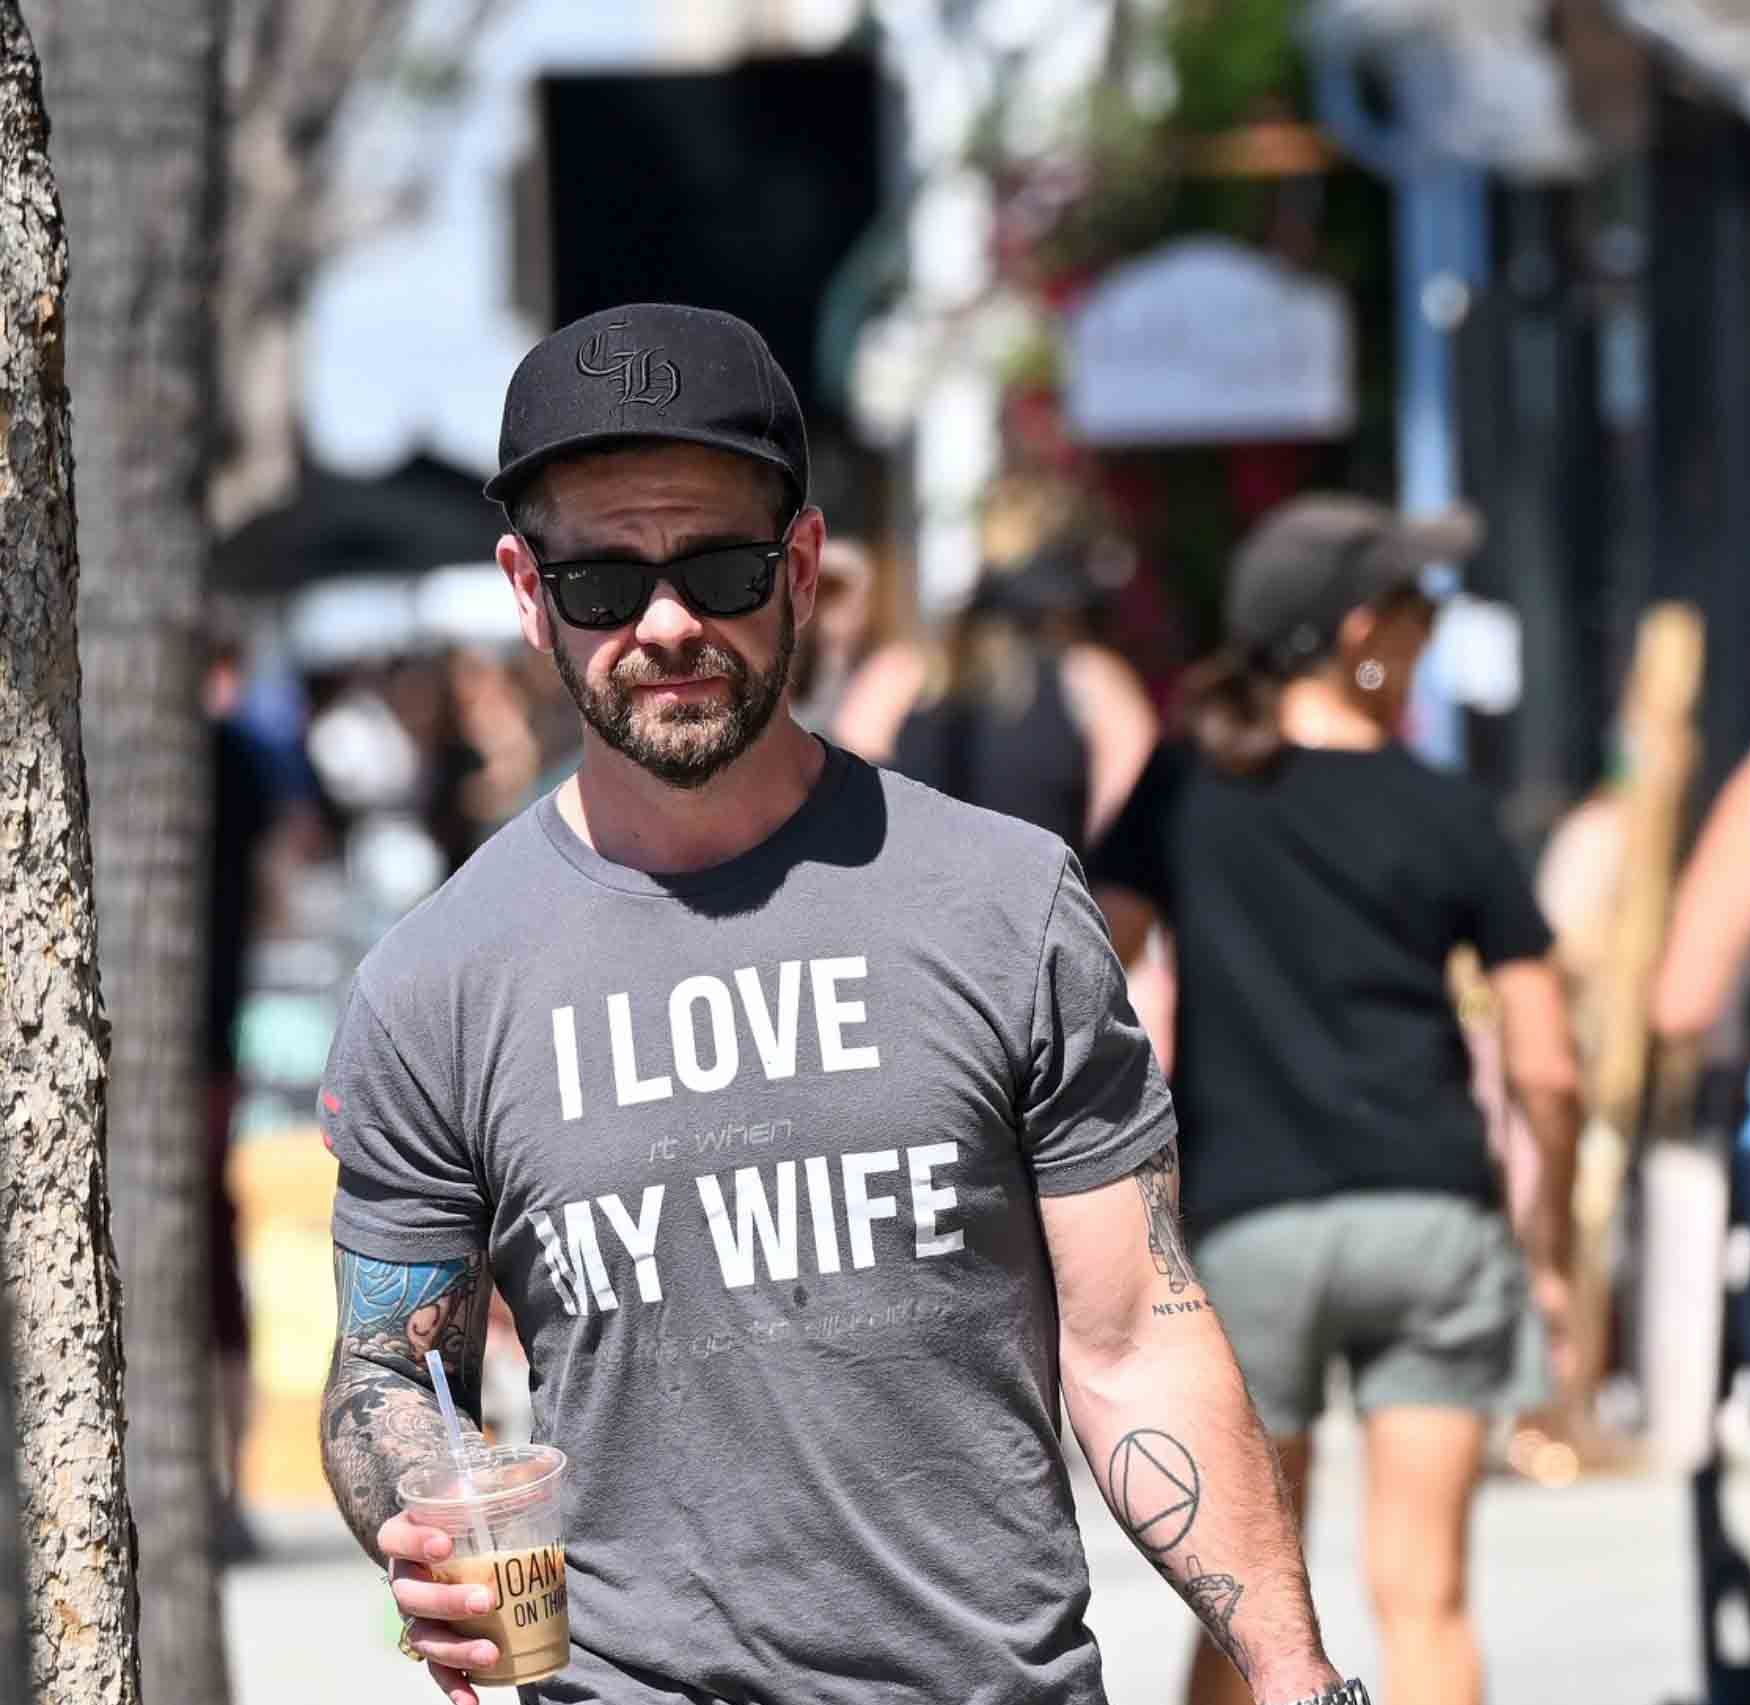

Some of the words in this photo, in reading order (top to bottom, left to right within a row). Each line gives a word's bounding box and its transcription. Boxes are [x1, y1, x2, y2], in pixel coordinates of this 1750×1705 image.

[551, 1005, 583, 1121] I
[606, 955, 880, 1107] LOVE
[528, 1184, 664, 1317] MY
[696, 1141, 965, 1290] WIFE
[1151, 1299, 1202, 1316] NEVER
[513, 1598, 538, 1628] ON
